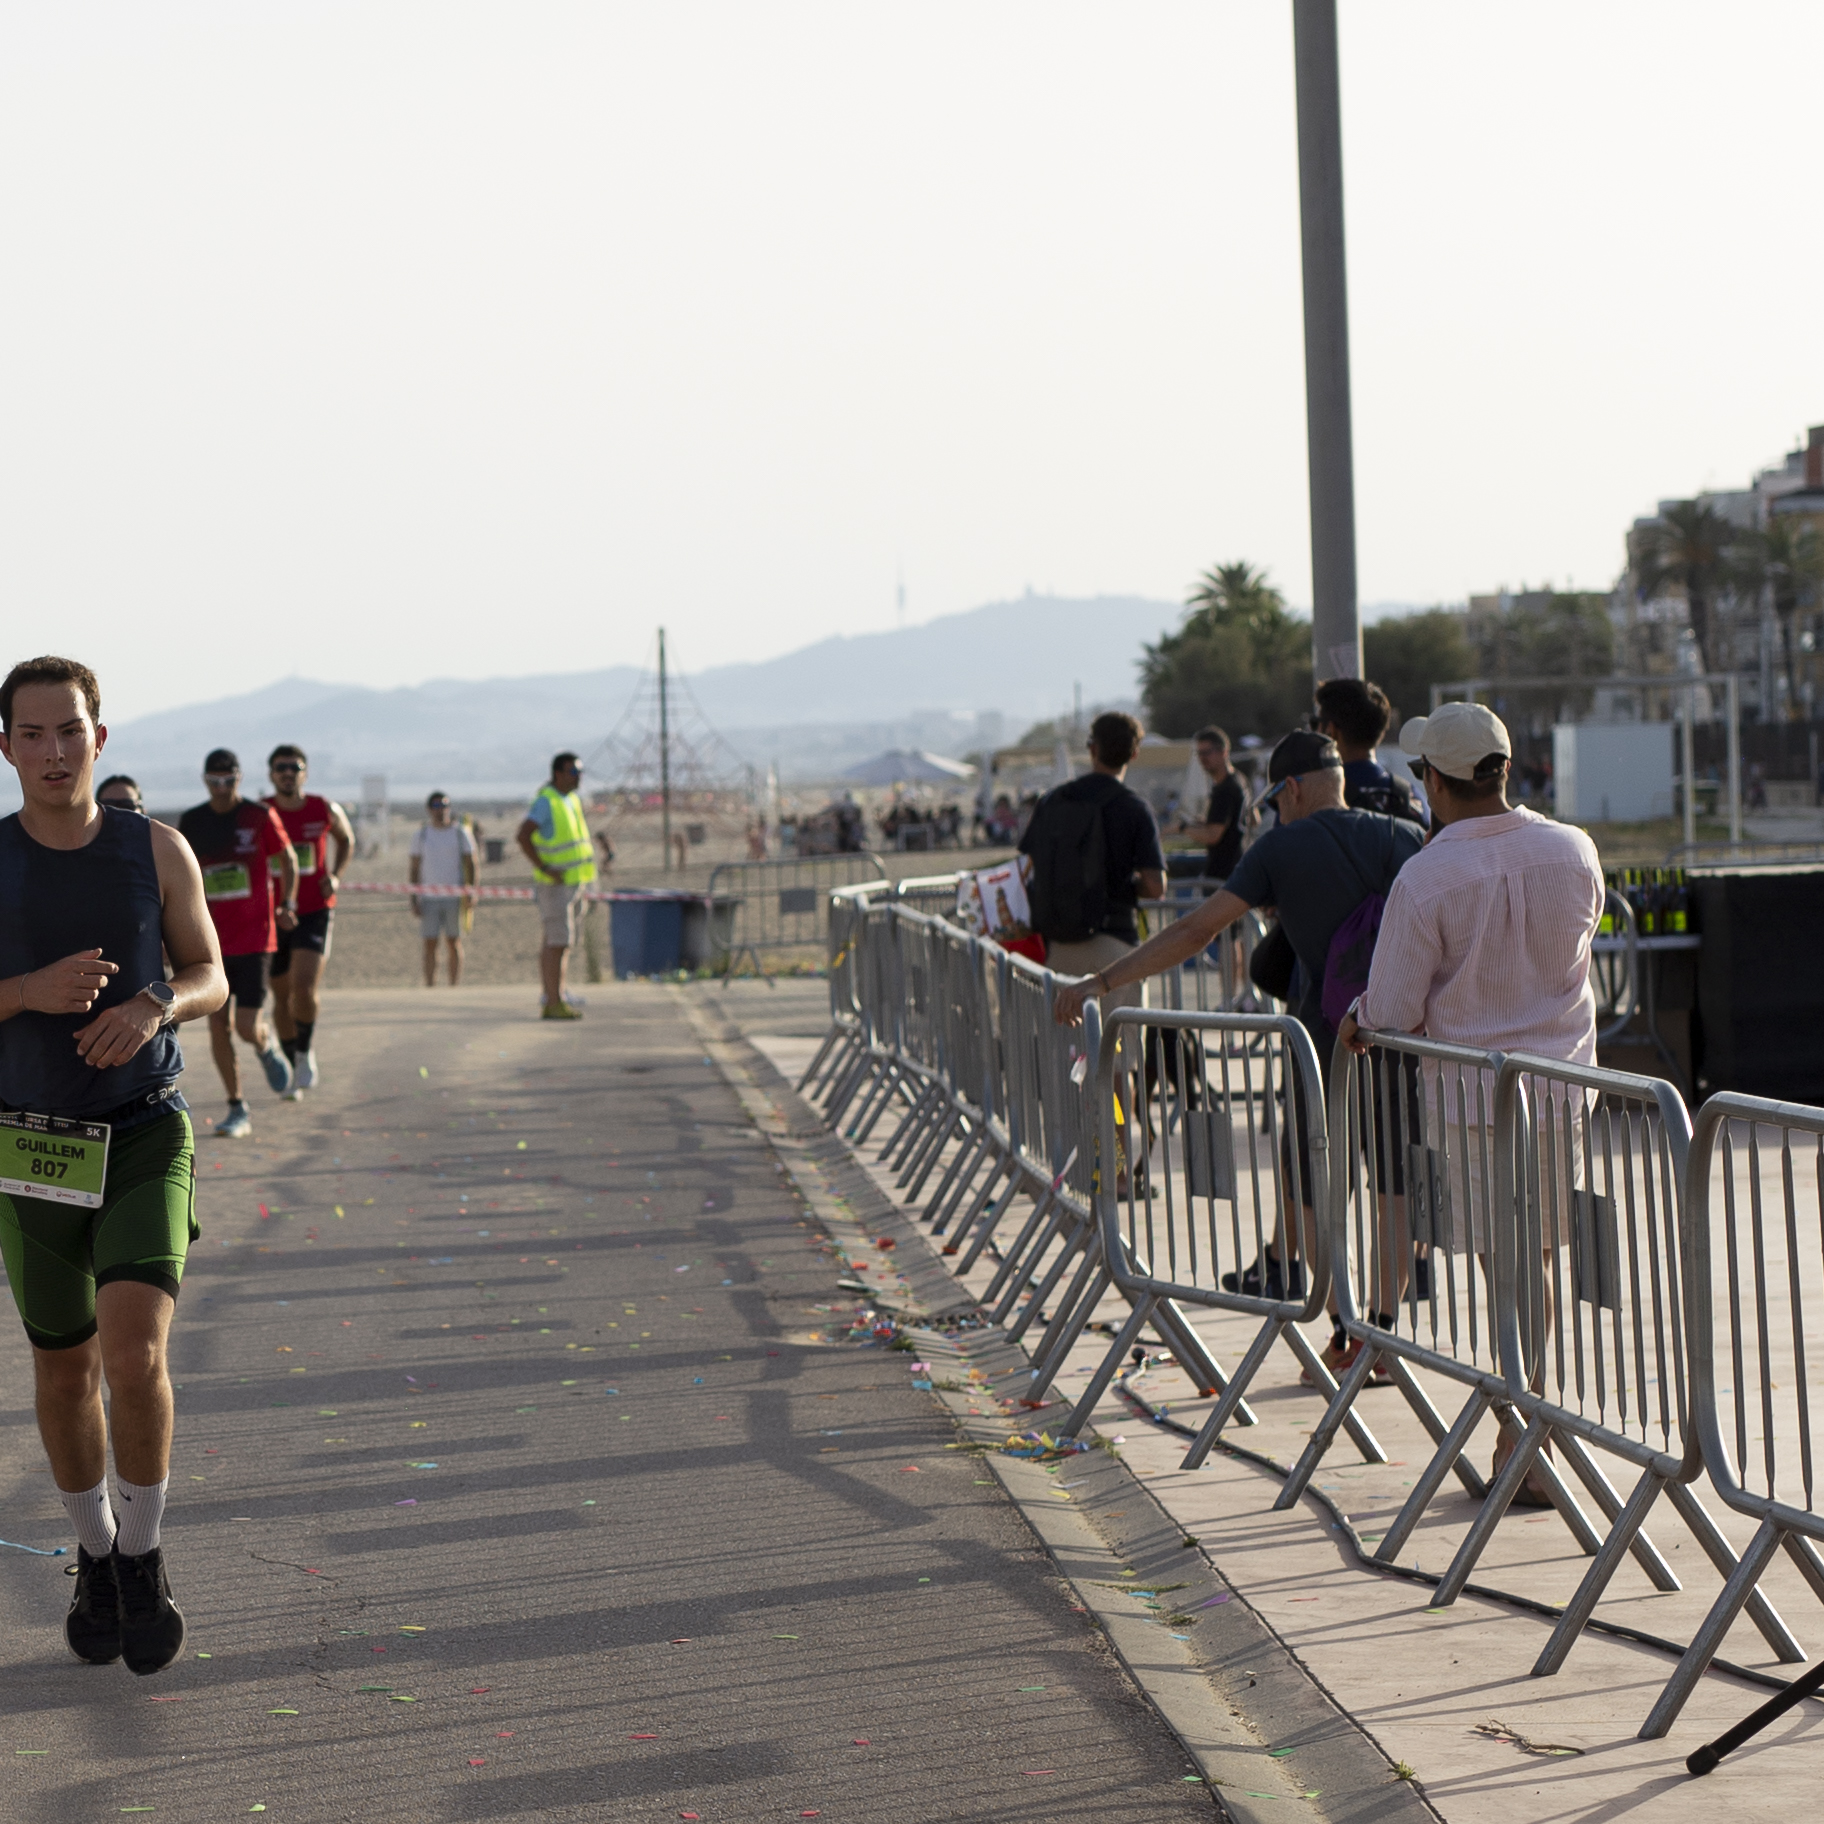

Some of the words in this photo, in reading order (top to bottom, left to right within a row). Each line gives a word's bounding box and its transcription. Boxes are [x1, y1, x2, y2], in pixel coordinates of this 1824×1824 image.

[86, 1127, 101, 1138] 5K
[15, 1137, 85, 1161] GUILLEM
[30, 1158, 68, 1179] 807
